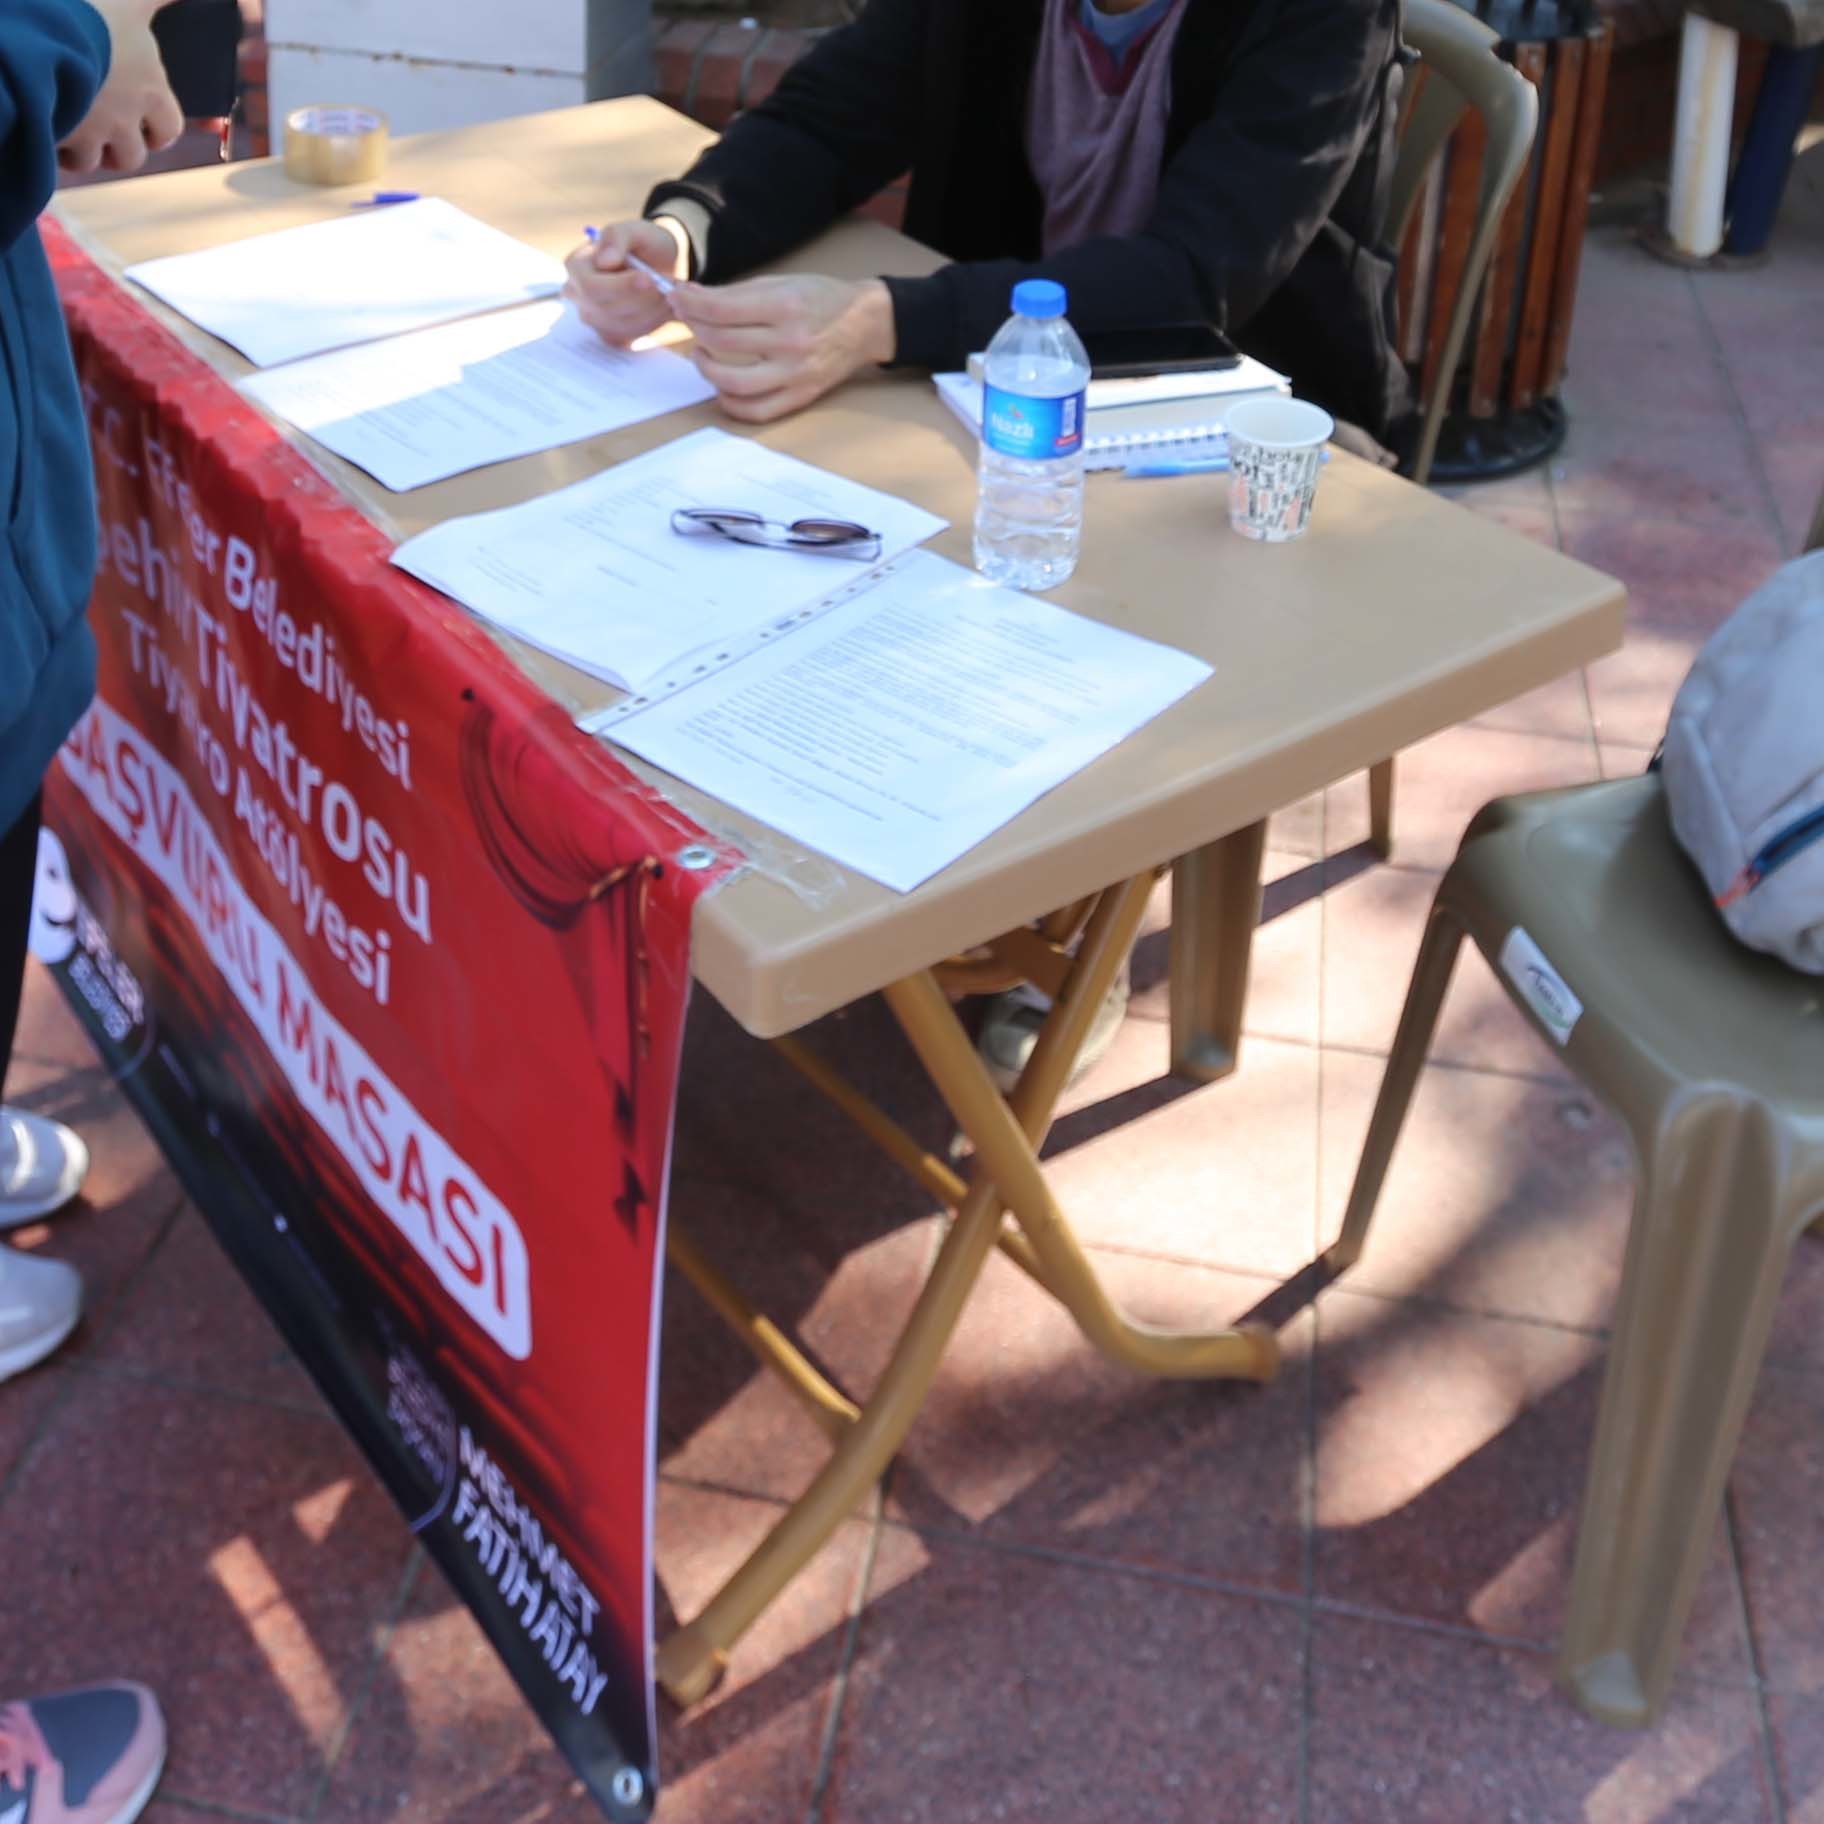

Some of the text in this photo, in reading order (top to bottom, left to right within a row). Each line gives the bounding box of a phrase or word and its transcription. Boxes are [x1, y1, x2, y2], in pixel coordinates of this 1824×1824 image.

[190, 602, 433, 946] Tiyatrosu
[223, 535, 414, 792] Belediyesi
[232, 764, 391, 1006] Atölyesi
[278, 958, 508, 1318] MASASI
